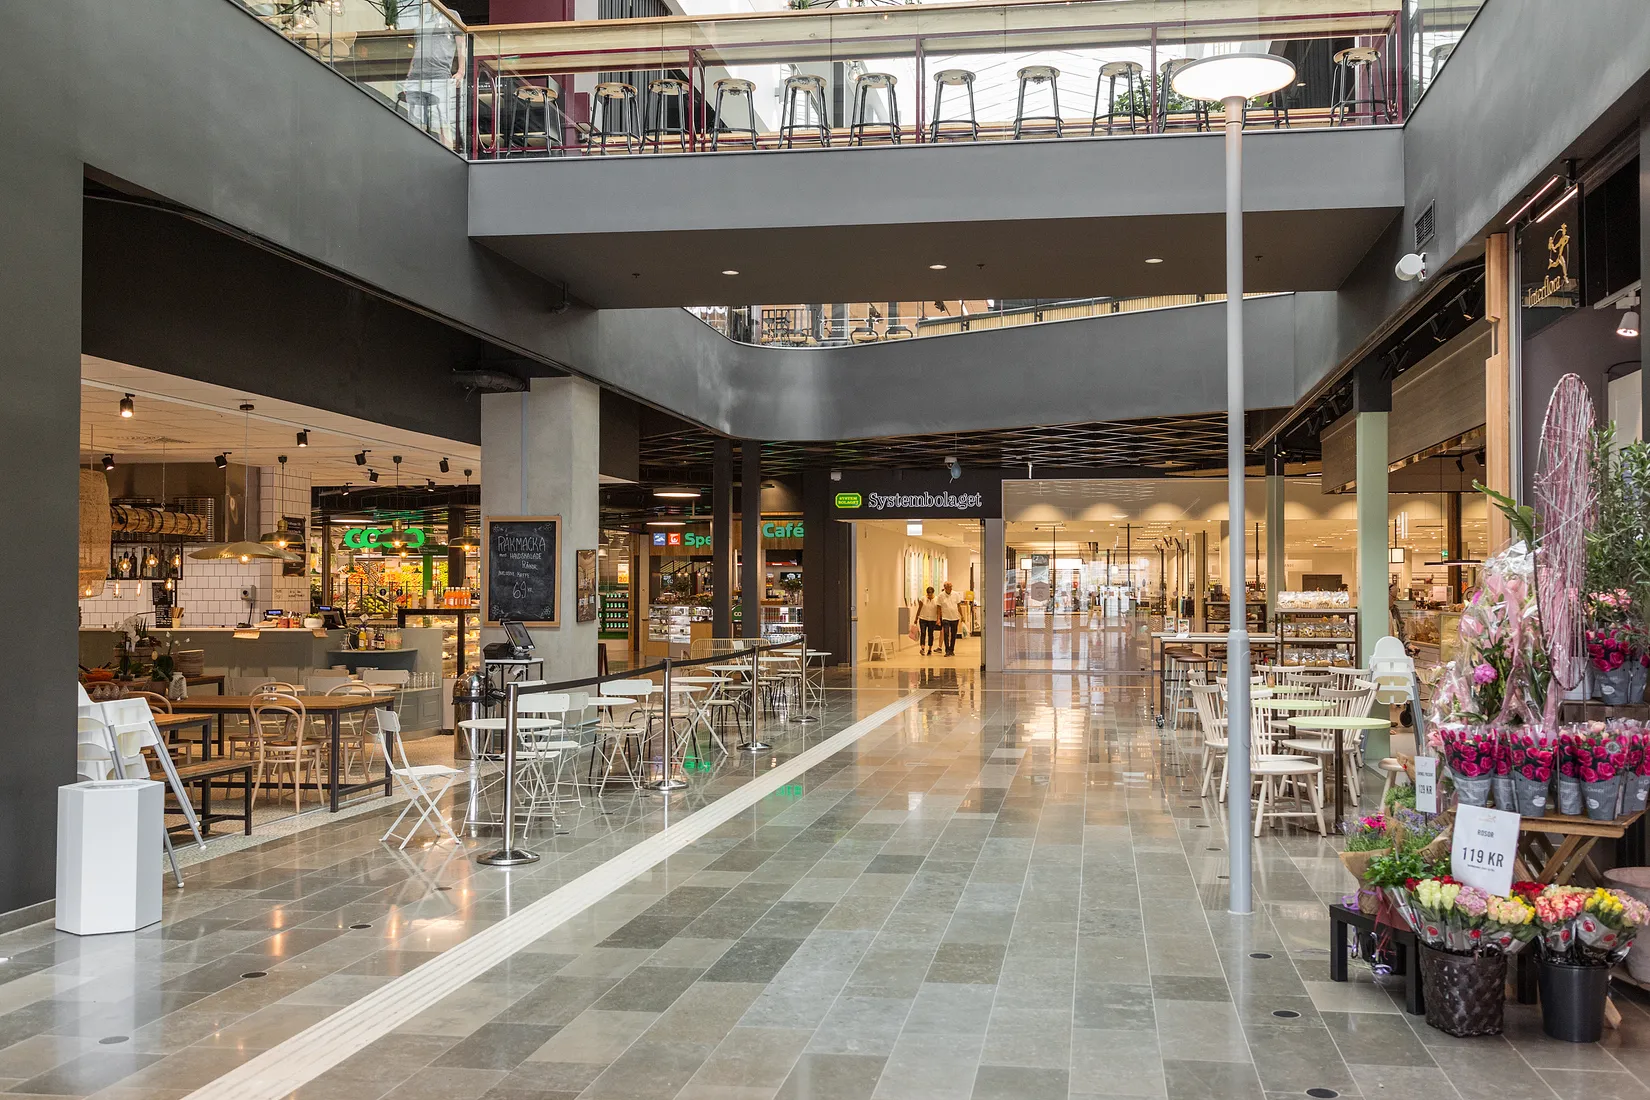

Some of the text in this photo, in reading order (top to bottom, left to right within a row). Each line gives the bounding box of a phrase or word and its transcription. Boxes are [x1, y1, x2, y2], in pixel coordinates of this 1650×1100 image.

[1528, 275, 1561, 308] Interflora
[868, 490, 982, 510] Systembolaget
[762, 522, 804, 538] Café
[513, 581, 526, 598] 69
[1477, 829, 1494, 838] ROSOR
[1463, 847, 1504, 867] 119 KR
